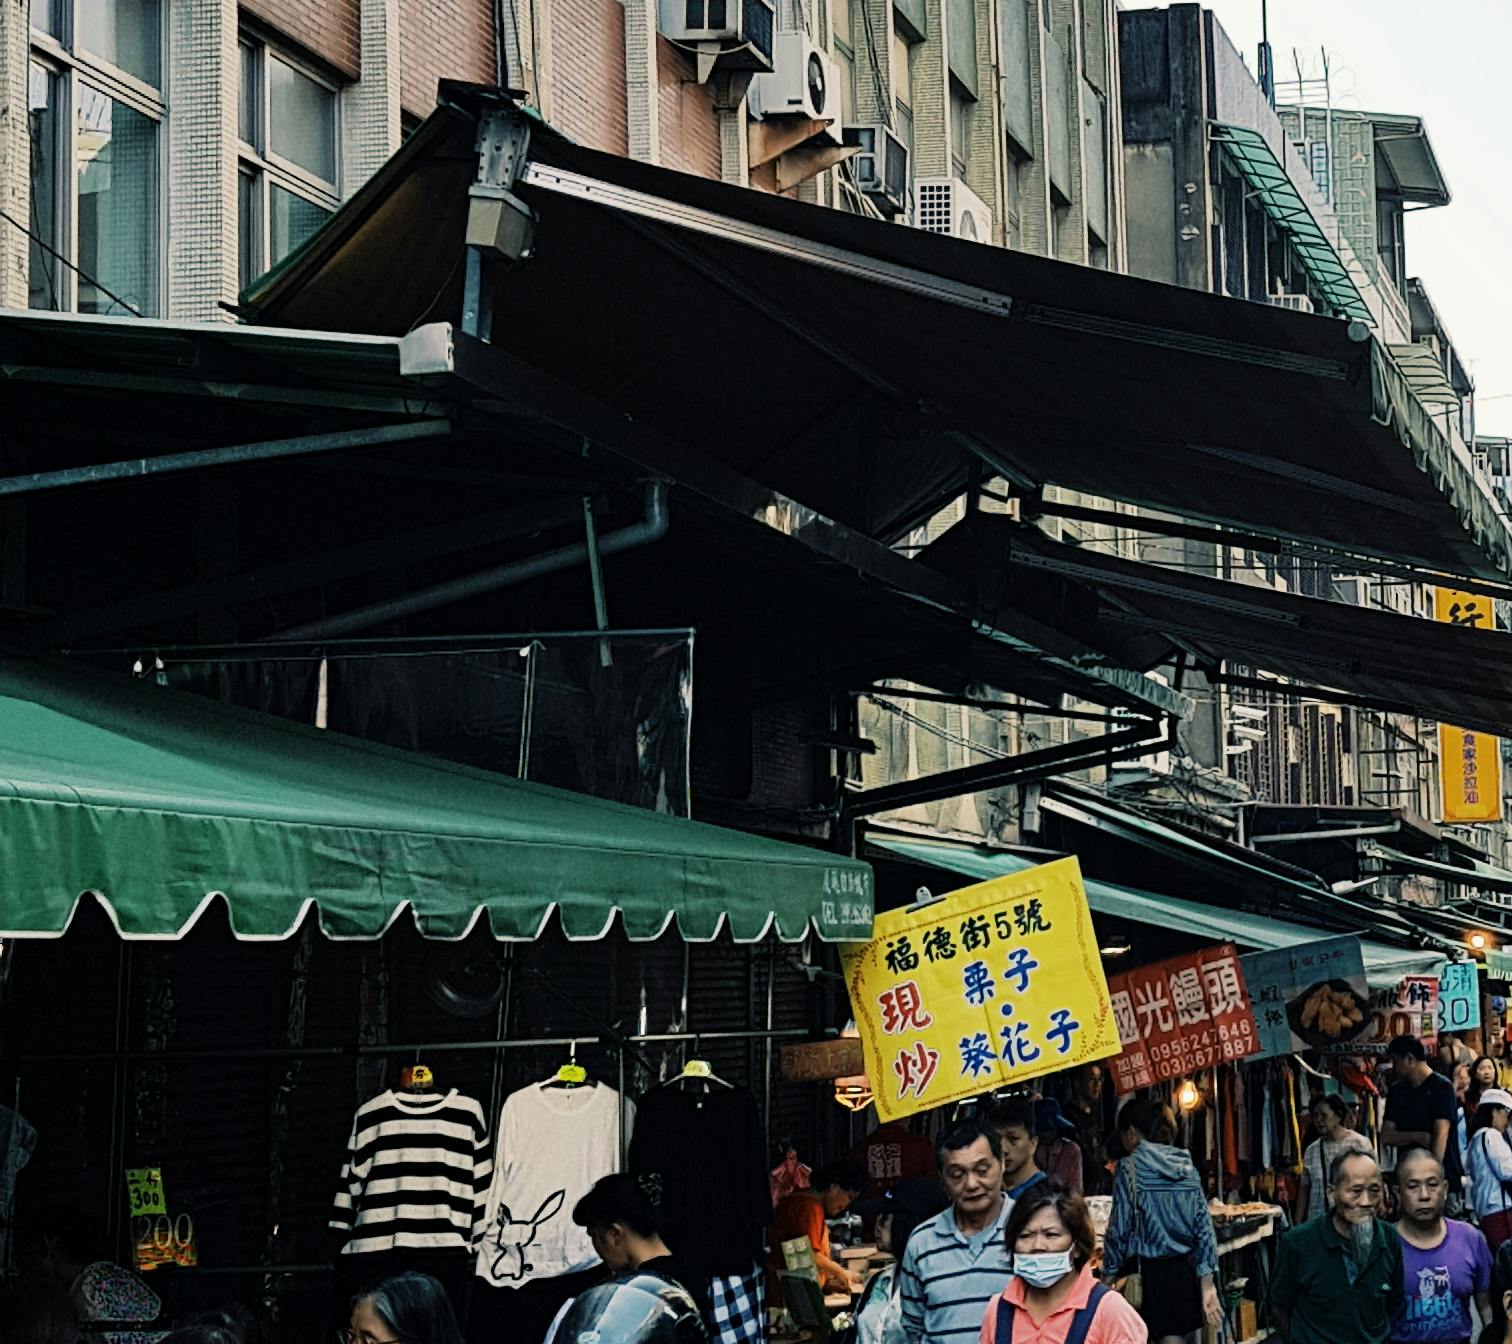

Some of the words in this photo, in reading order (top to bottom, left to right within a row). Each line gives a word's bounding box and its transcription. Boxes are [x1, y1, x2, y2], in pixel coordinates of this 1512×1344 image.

[885, 899, 1052, 974] 福德街5號
[964, 948, 1039, 1004] 栗子
[1111, 958, 1245, 1045] 國光饅頭
[959, 1009, 1080, 1078] 葵花子
[132, 1187, 160, 1209] 300
[136, 1212, 194, 1249] 200
